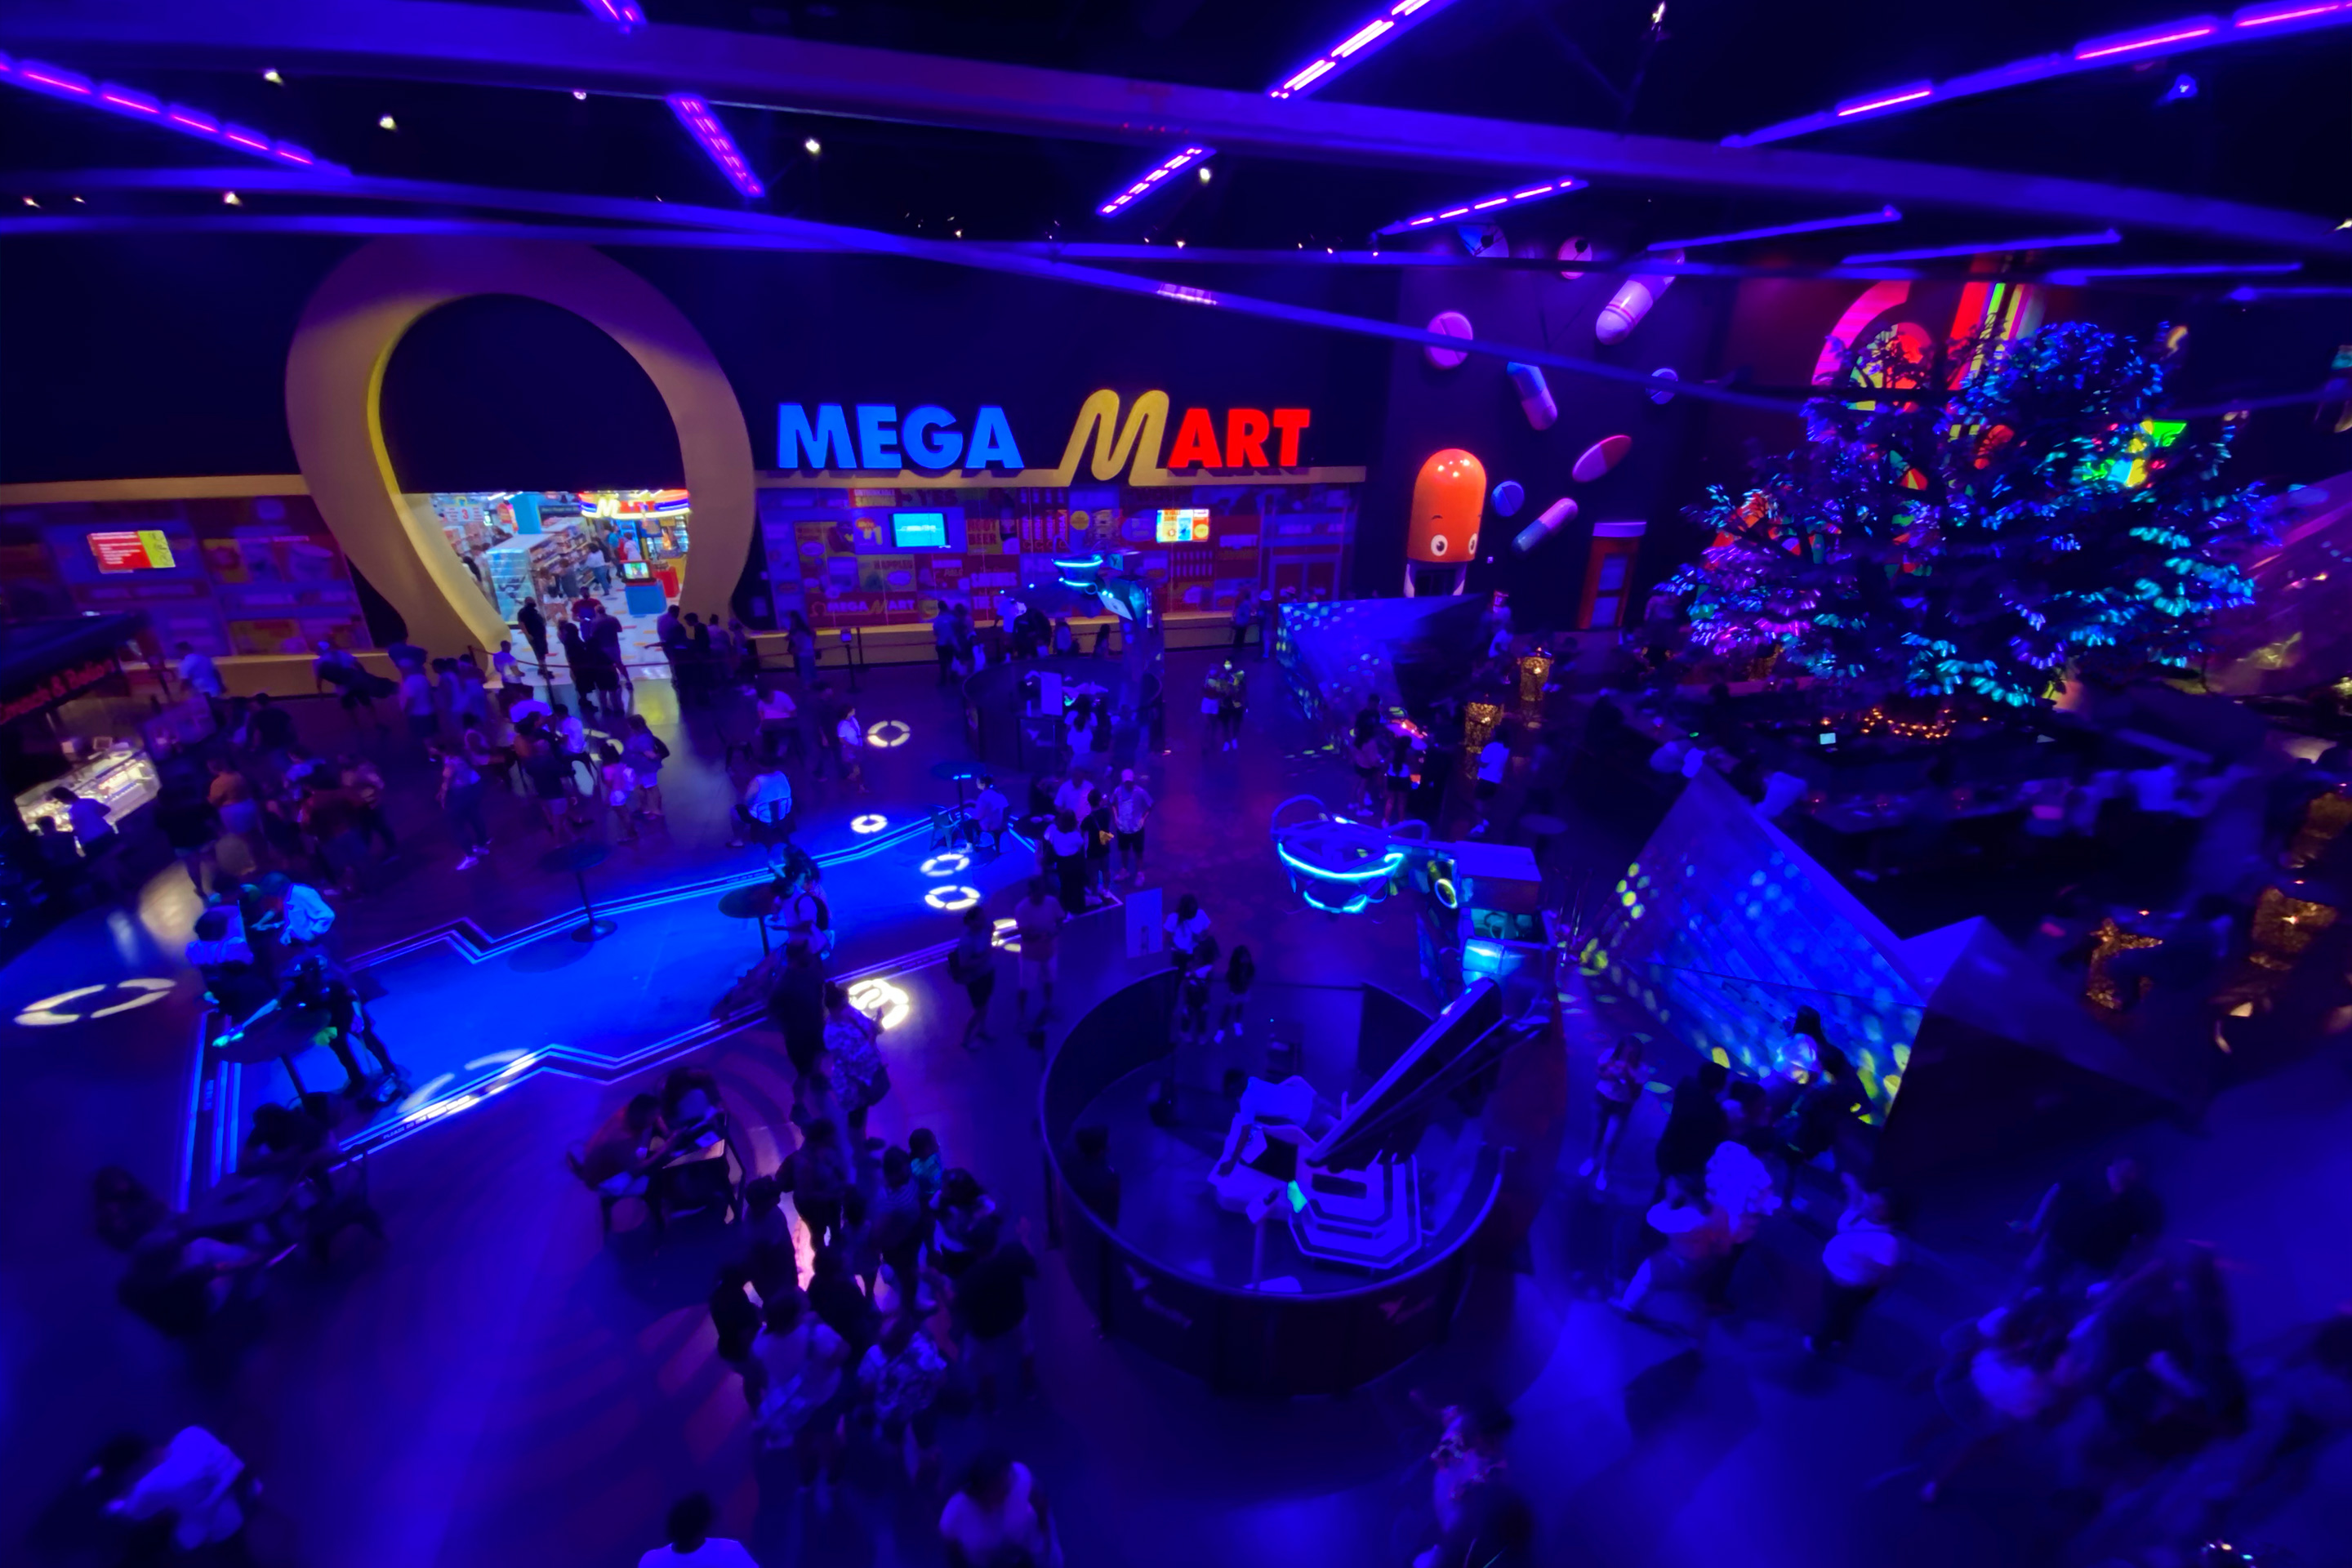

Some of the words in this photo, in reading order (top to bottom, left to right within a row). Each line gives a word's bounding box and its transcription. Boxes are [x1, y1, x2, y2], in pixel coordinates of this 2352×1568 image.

[778, 403, 1025, 468] MEGA
[1058, 389, 1312, 486] MART
[461, 509, 469, 519] 3
[826, 599, 869, 612] MEGA
